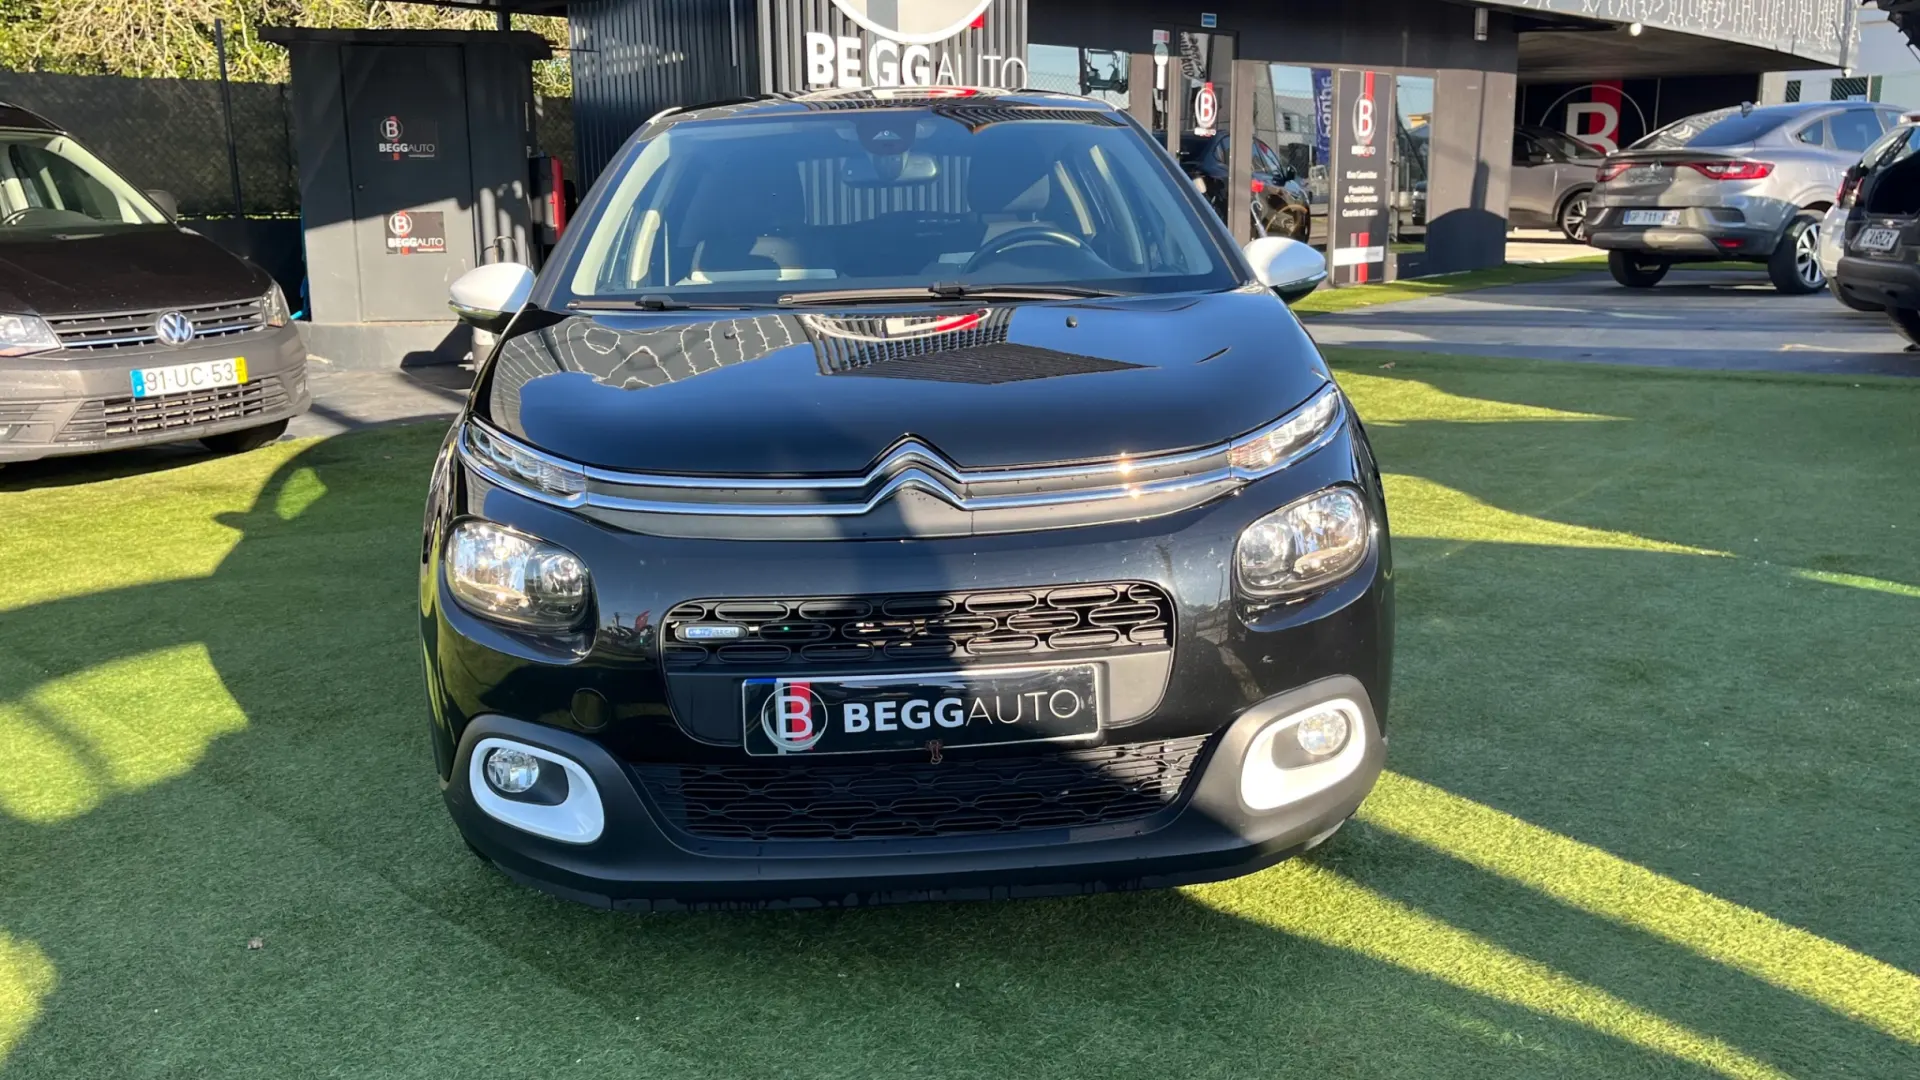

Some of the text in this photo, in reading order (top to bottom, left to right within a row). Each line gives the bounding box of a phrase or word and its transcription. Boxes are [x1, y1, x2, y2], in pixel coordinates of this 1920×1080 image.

[806, 32, 1028, 89] BEGGAUTO
[378, 143, 436, 153] BEGGAUTO
[387, 237, 444, 248] BEGGAUTO
[843, 689, 1079, 733] BEGGAUTO
